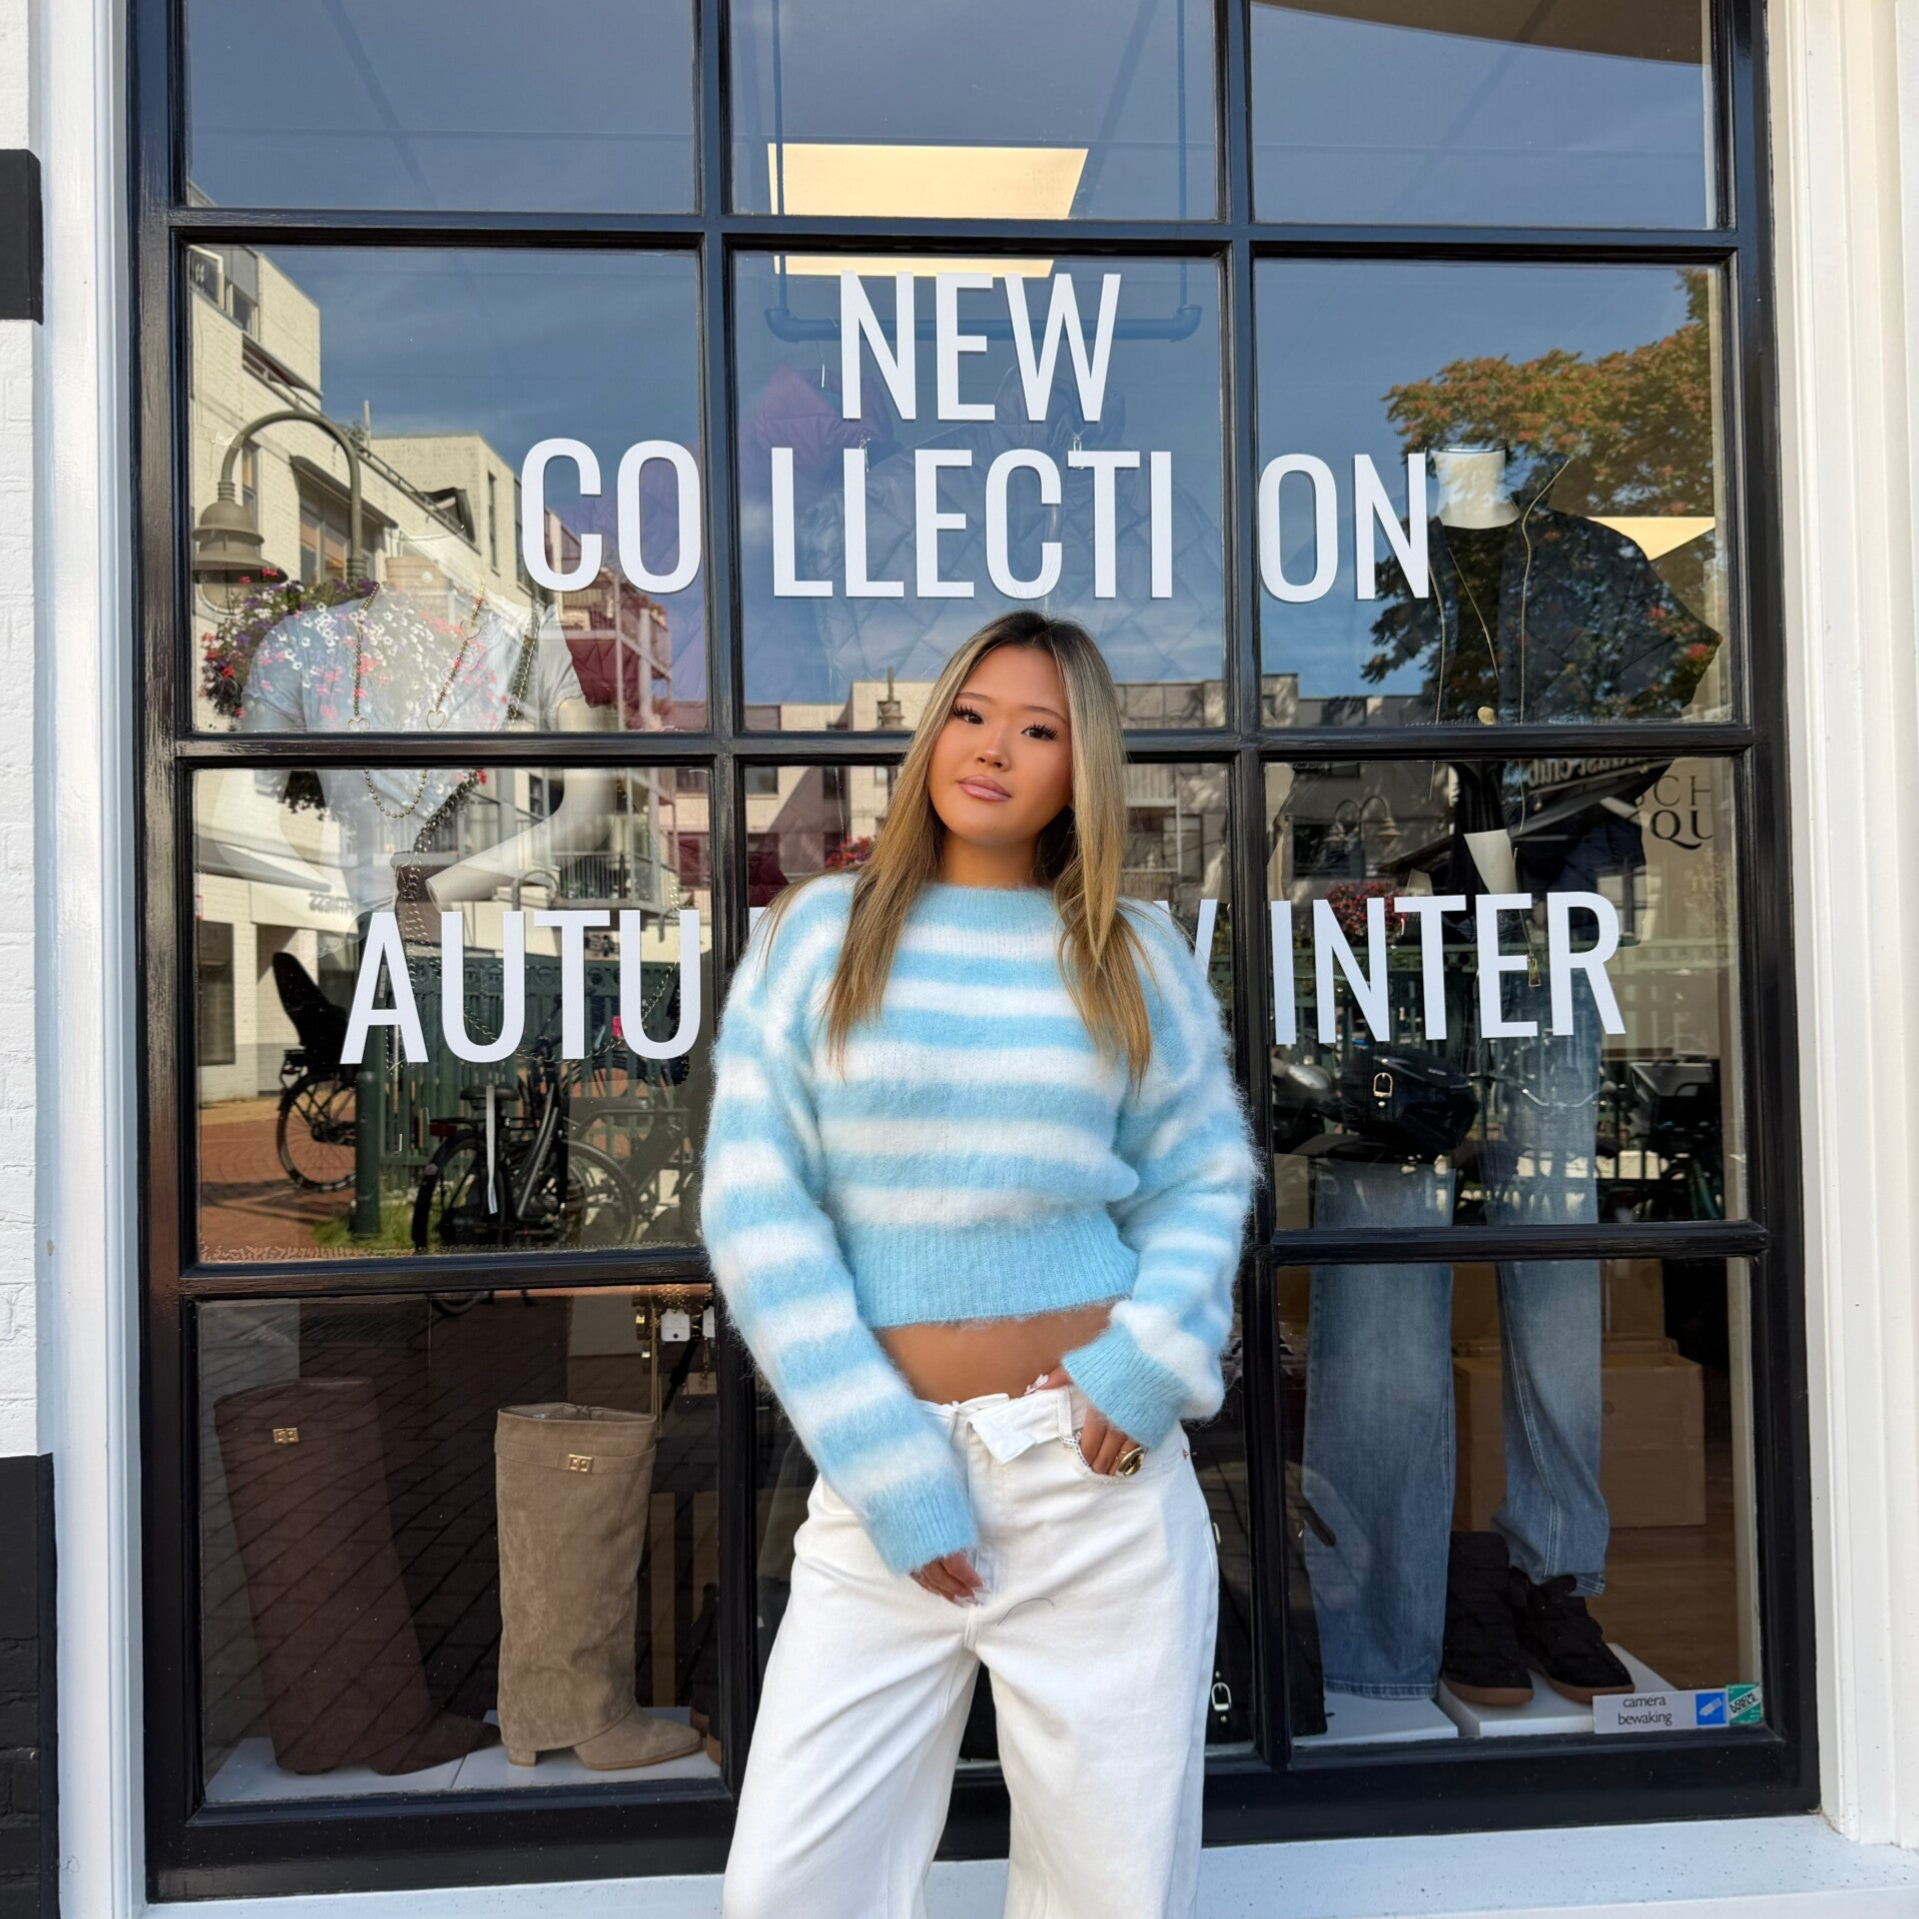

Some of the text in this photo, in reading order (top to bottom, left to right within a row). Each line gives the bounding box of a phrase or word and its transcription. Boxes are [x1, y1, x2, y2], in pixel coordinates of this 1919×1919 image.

[840, 270, 1121, 422] NEW
[340, 907, 772, 1064] AUTU
[1618, 1711, 1673, 1727] bewaking
[1623, 1696, 1666, 1708] camera
